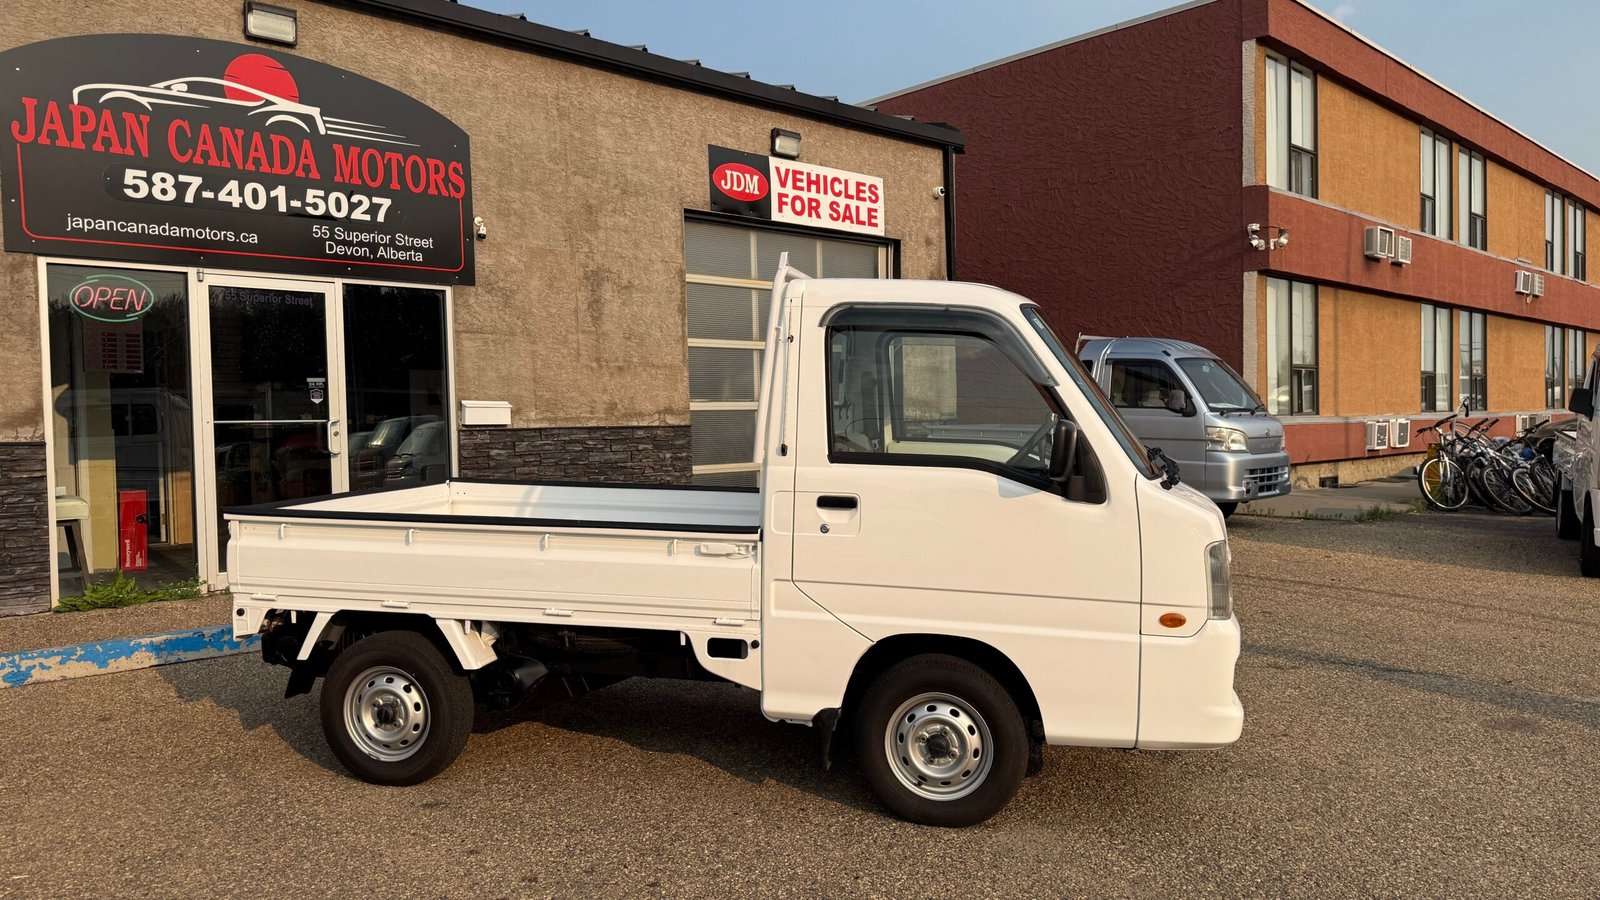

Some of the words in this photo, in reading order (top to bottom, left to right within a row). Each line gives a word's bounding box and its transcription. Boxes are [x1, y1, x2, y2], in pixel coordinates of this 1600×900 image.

[11, 97, 150, 157] JAPAN
[167, 118, 320, 180] CANADA
[332, 143, 465, 199] MOTORS
[123, 168, 392, 223] 587-401-5027
[721, 169, 759, 195] JDM
[775, 166, 880, 204] VEHICLES
[777, 192, 822, 219] FOR
[829, 200, 878, 228] SALE
[66, 213, 258, 244] japancanadamotors.ca
[312, 225, 330, 239] 55
[334, 227, 392, 246] Superior
[395, 234, 434, 249] Street
[325, 240, 374, 259] Devon,
[377, 244, 423, 262] Alberta
[74, 285, 146, 311] OPEN
[239, 291, 282, 304] Superior
[284, 294, 313, 307] Street
